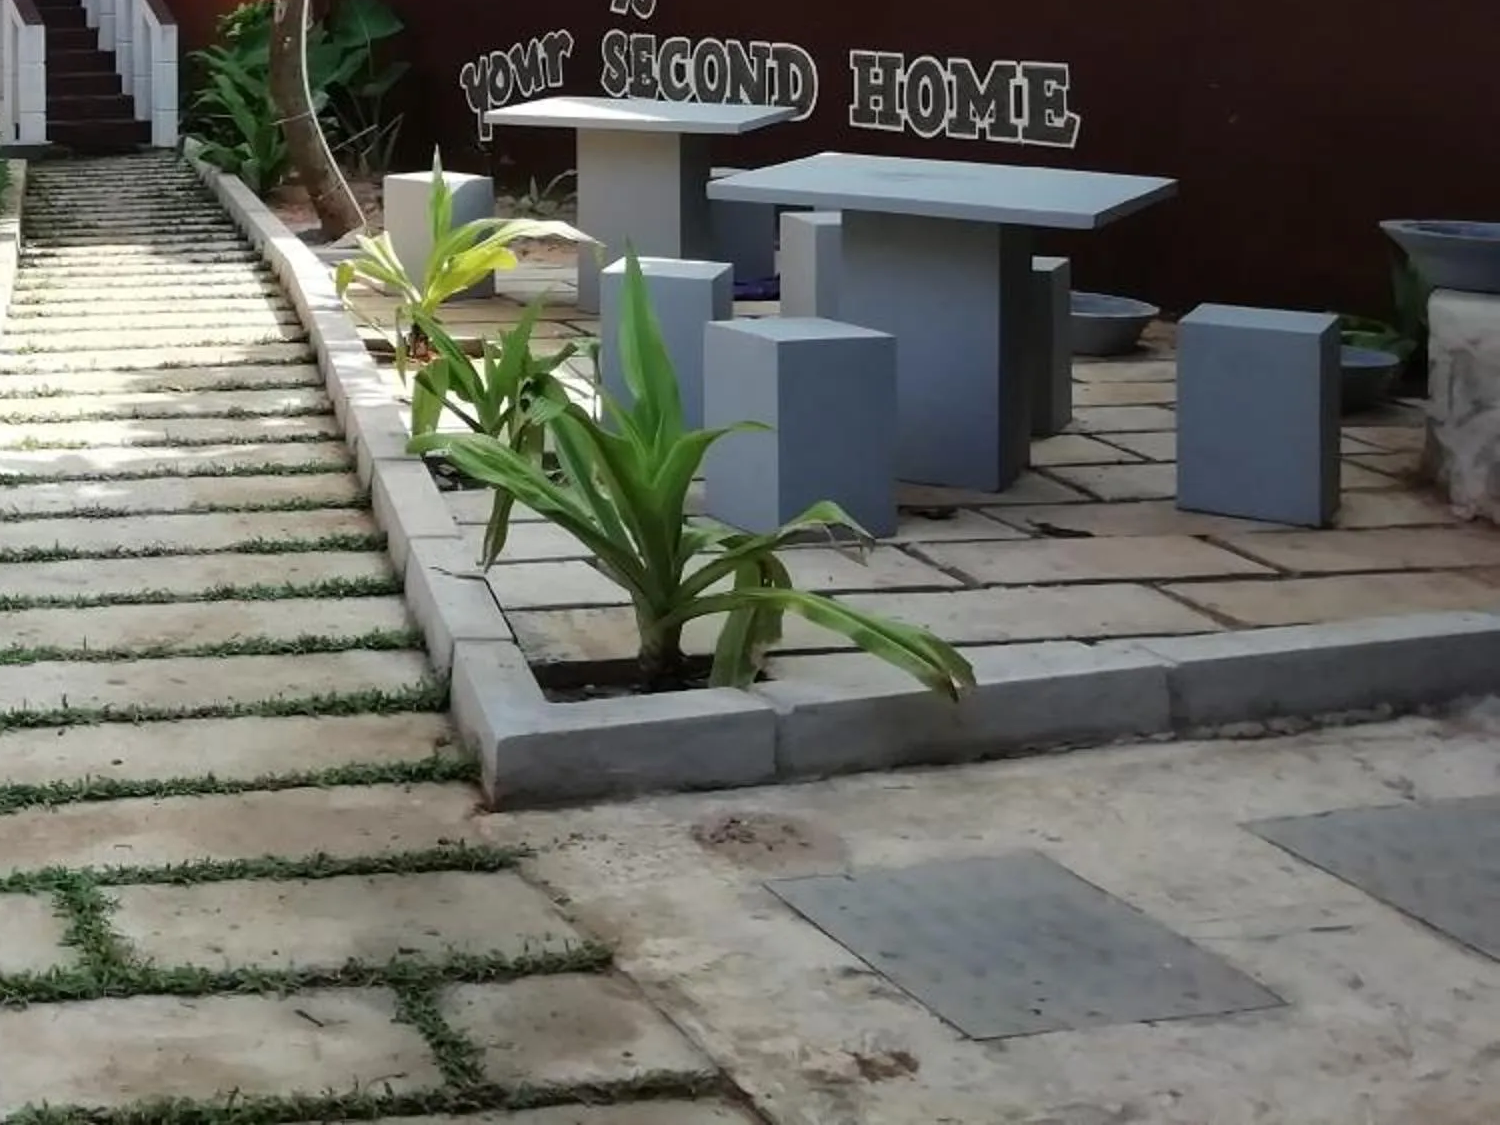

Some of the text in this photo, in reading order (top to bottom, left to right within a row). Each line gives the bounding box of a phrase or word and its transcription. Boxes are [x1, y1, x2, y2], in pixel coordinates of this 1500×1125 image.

[460, 29, 1081, 148] your SECOND HOME
